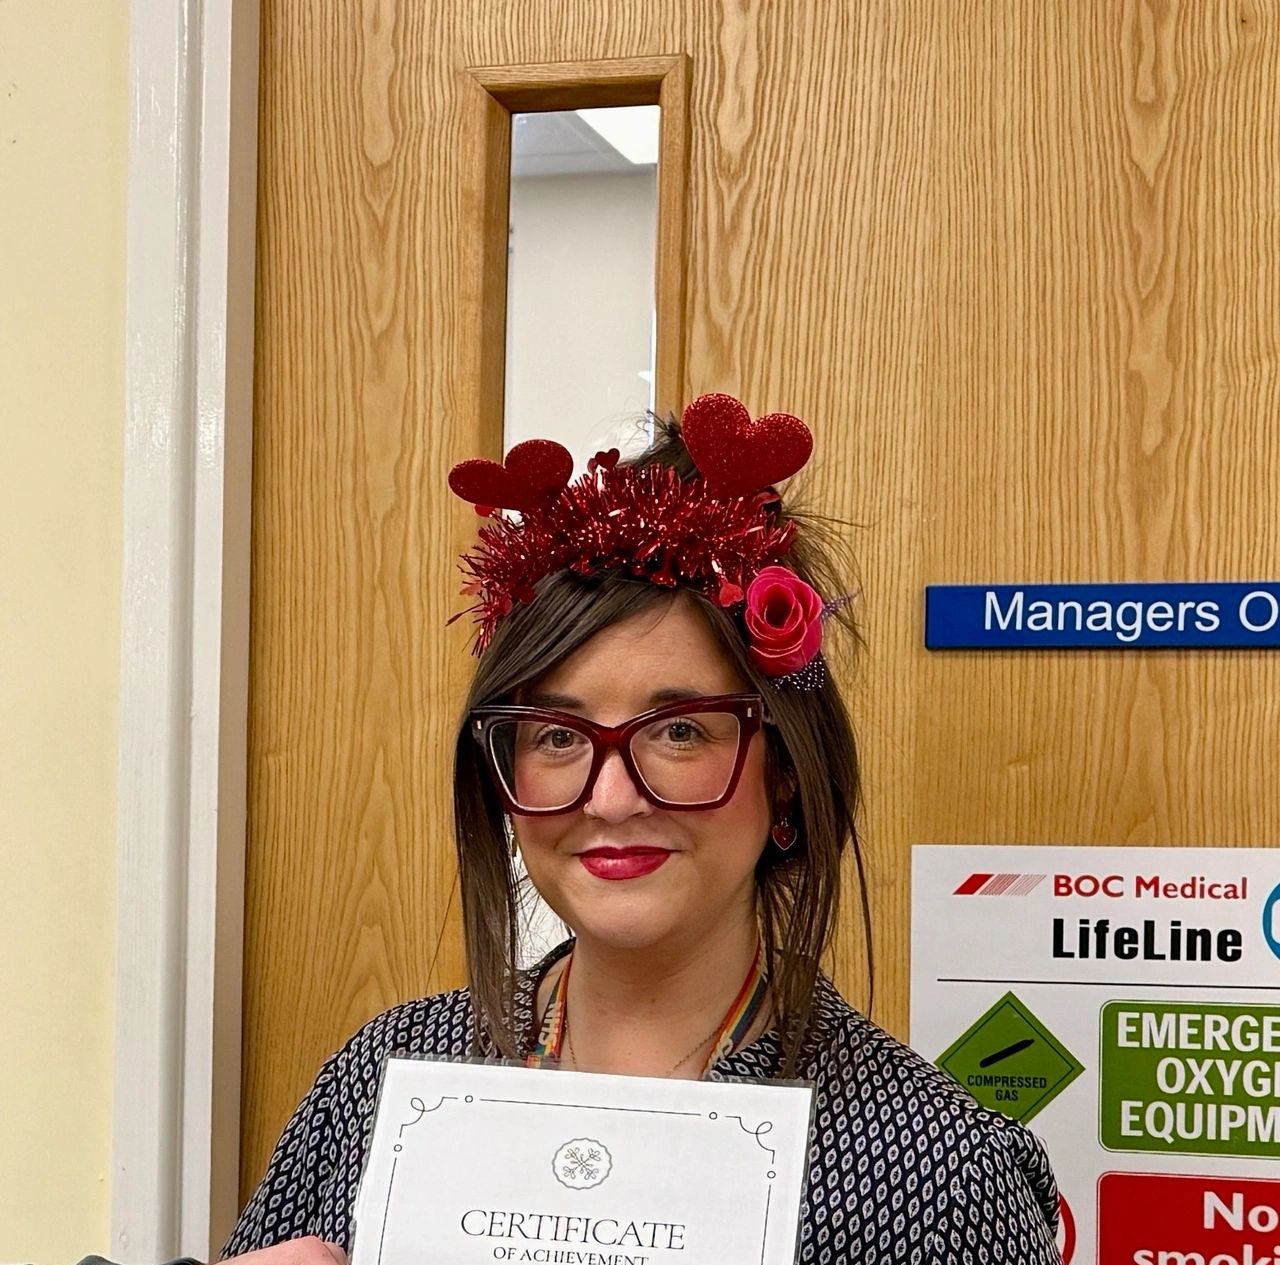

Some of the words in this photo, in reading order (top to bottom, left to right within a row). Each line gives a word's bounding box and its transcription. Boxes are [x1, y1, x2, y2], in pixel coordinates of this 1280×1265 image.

[984, 591, 1220, 642] Managers
[1238, 590, 1279, 632] O
[1053, 874, 1124, 898] BOC
[1135, 875, 1248, 900] Medical
[1052, 918, 1243, 962] LifeLine
[1117, 1011, 1280, 1053] EMERGE
[967, 1075, 1047, 1089] COMPRESSED
[995, 1089, 1019, 1102] GAS
[1120, 1100, 1280, 1144] EQUIPM
[461, 1209, 686, 1250] CERTIFICATE
[1203, 1191, 1280, 1233] No
[493, 1246, 517, 1260] OF
